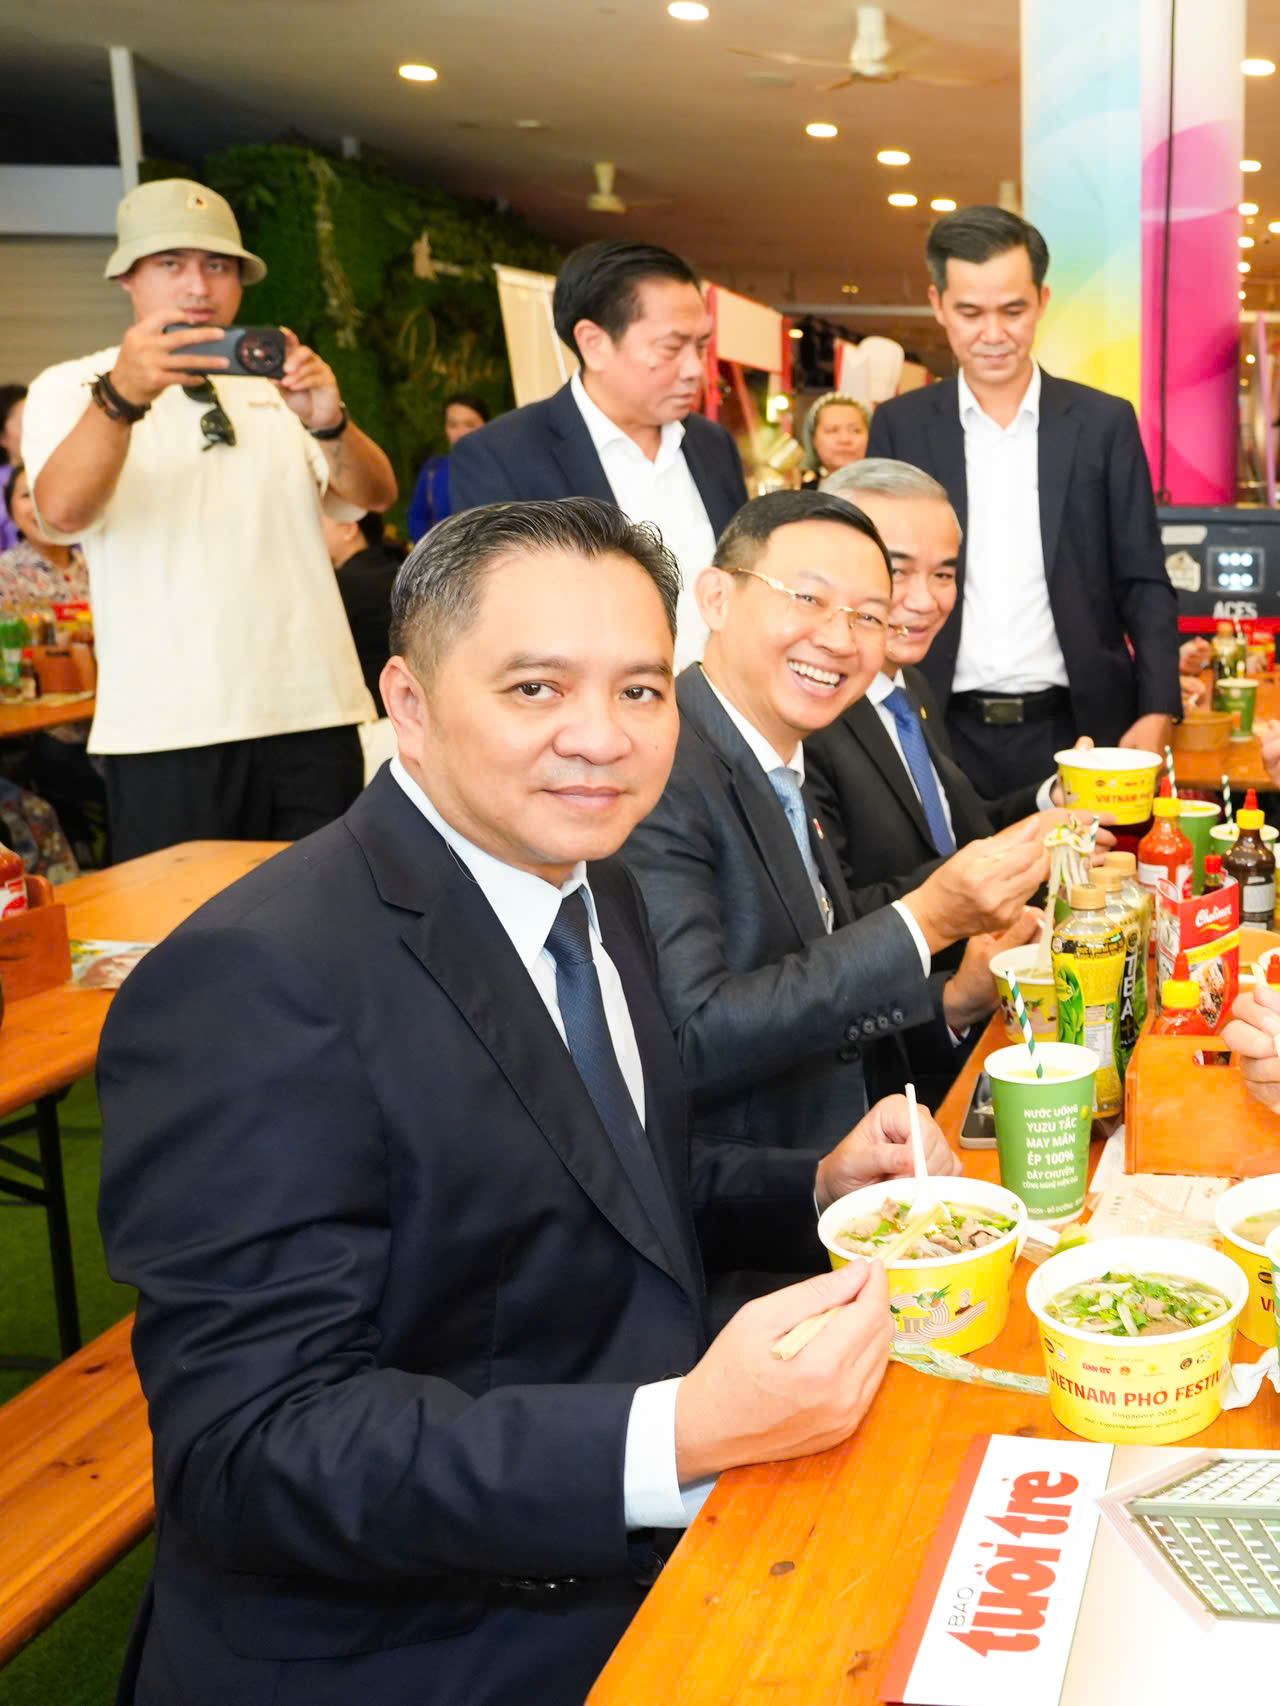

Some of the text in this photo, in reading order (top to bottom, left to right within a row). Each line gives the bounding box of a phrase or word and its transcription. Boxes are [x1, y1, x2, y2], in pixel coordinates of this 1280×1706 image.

[1027, 1121, 1057, 1133] YUZU
[1026, 1137, 1050, 1149] MAY
[1045, 1149, 1075, 1165] 100%
[1049, 1369, 1116, 1406] VIETNAM
